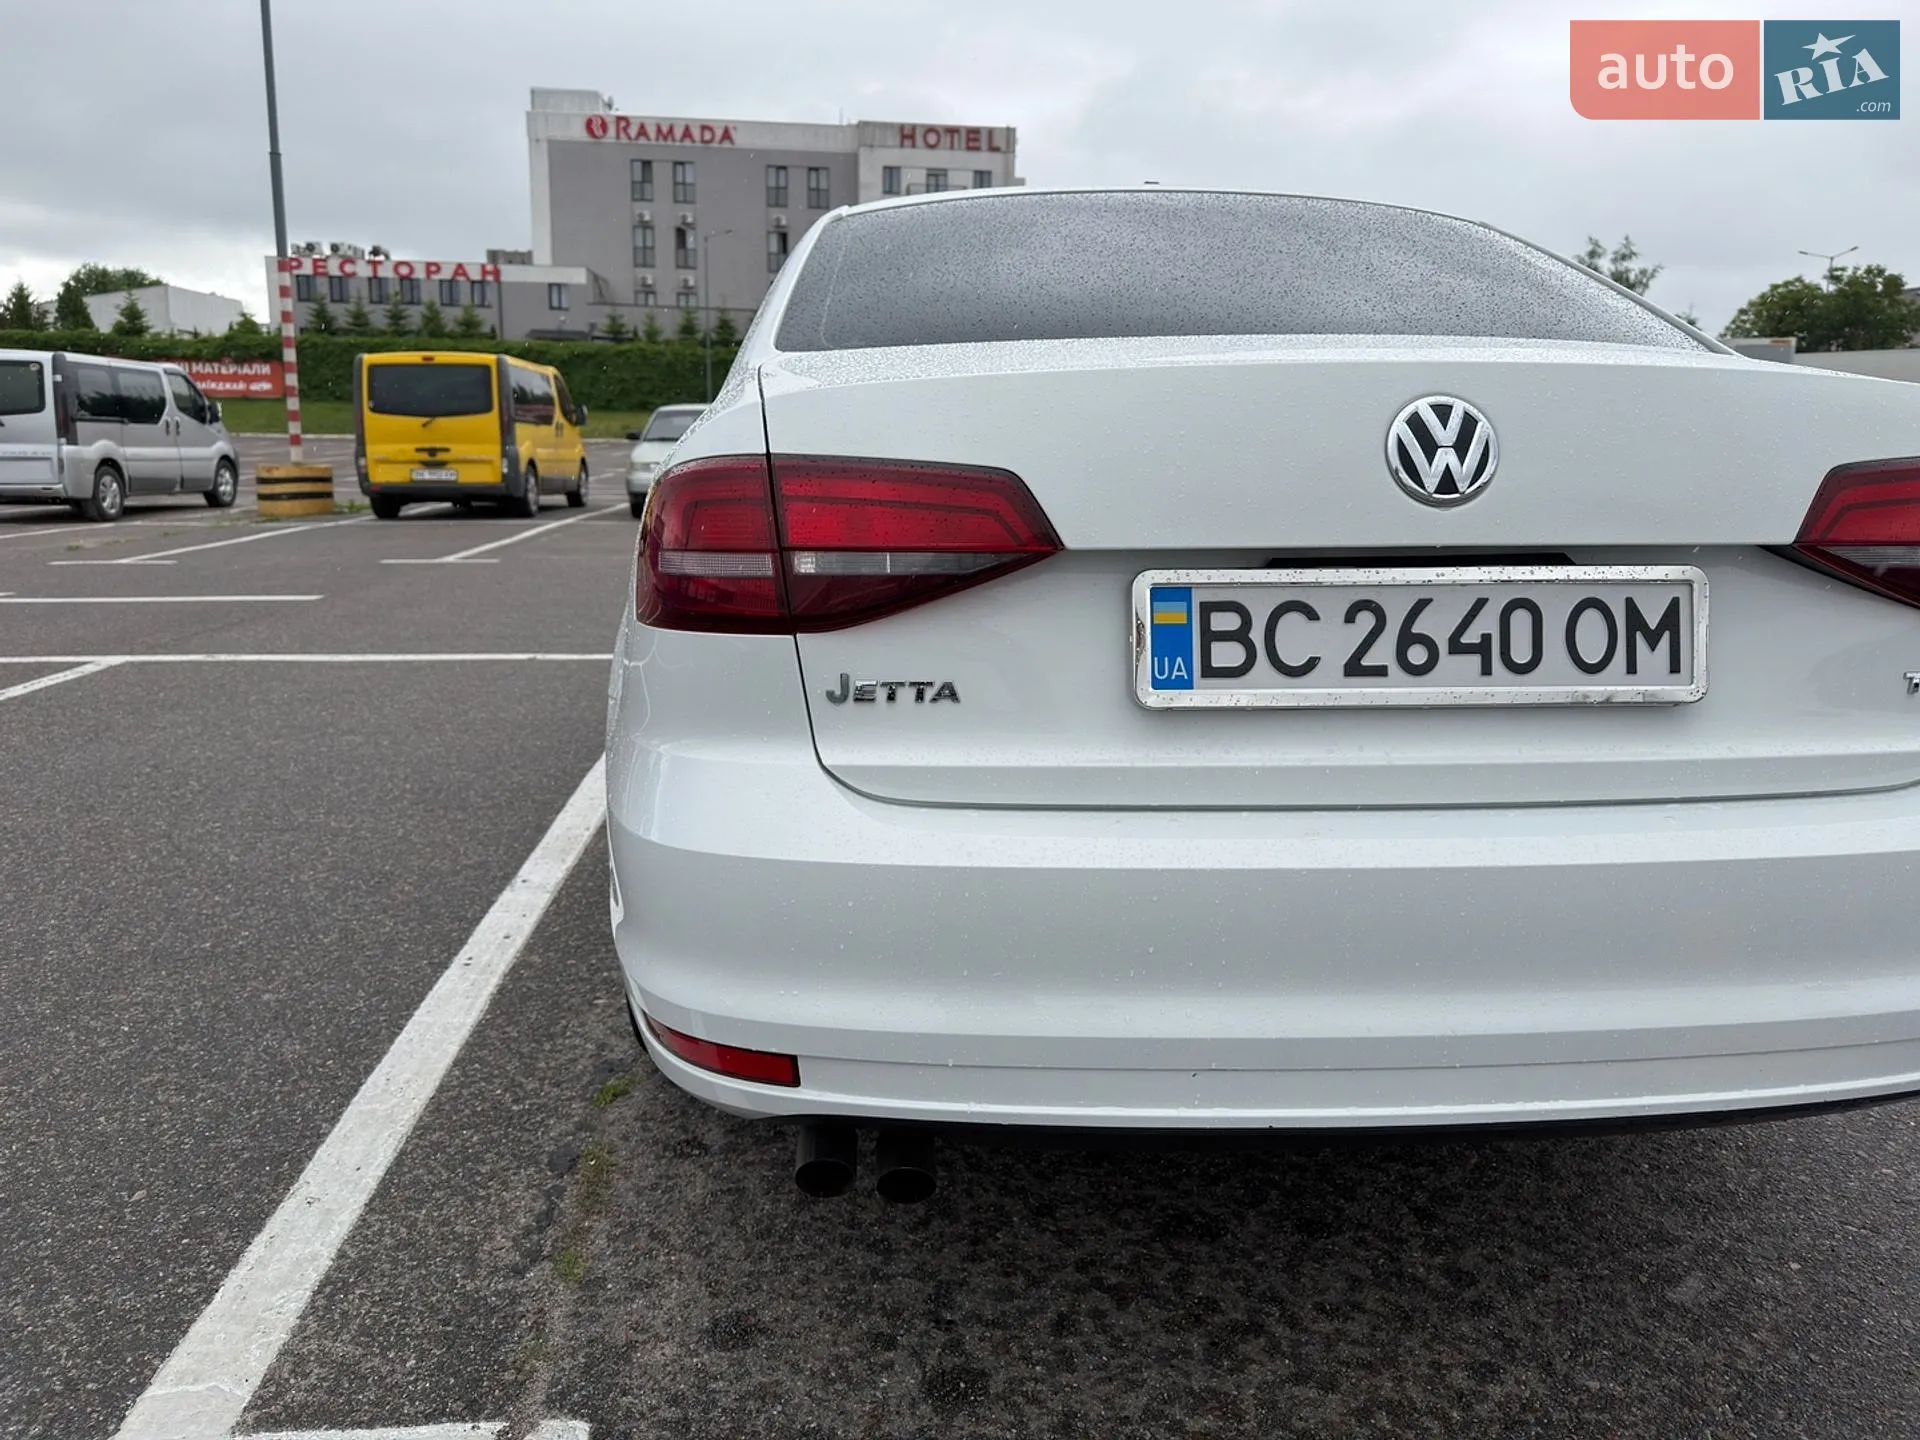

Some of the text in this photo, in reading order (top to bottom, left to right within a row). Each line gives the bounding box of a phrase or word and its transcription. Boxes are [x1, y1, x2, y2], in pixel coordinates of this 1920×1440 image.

[615, 115, 735, 146] RAMADA
[899, 124, 1001, 153] HOTEL
[287, 256, 500, 283] РЕСТОРАН
[1200, 596, 1681, 679] BC 2640 OM
[1153, 656, 1189, 680] UA
[825, 673, 961, 705] JETTA
